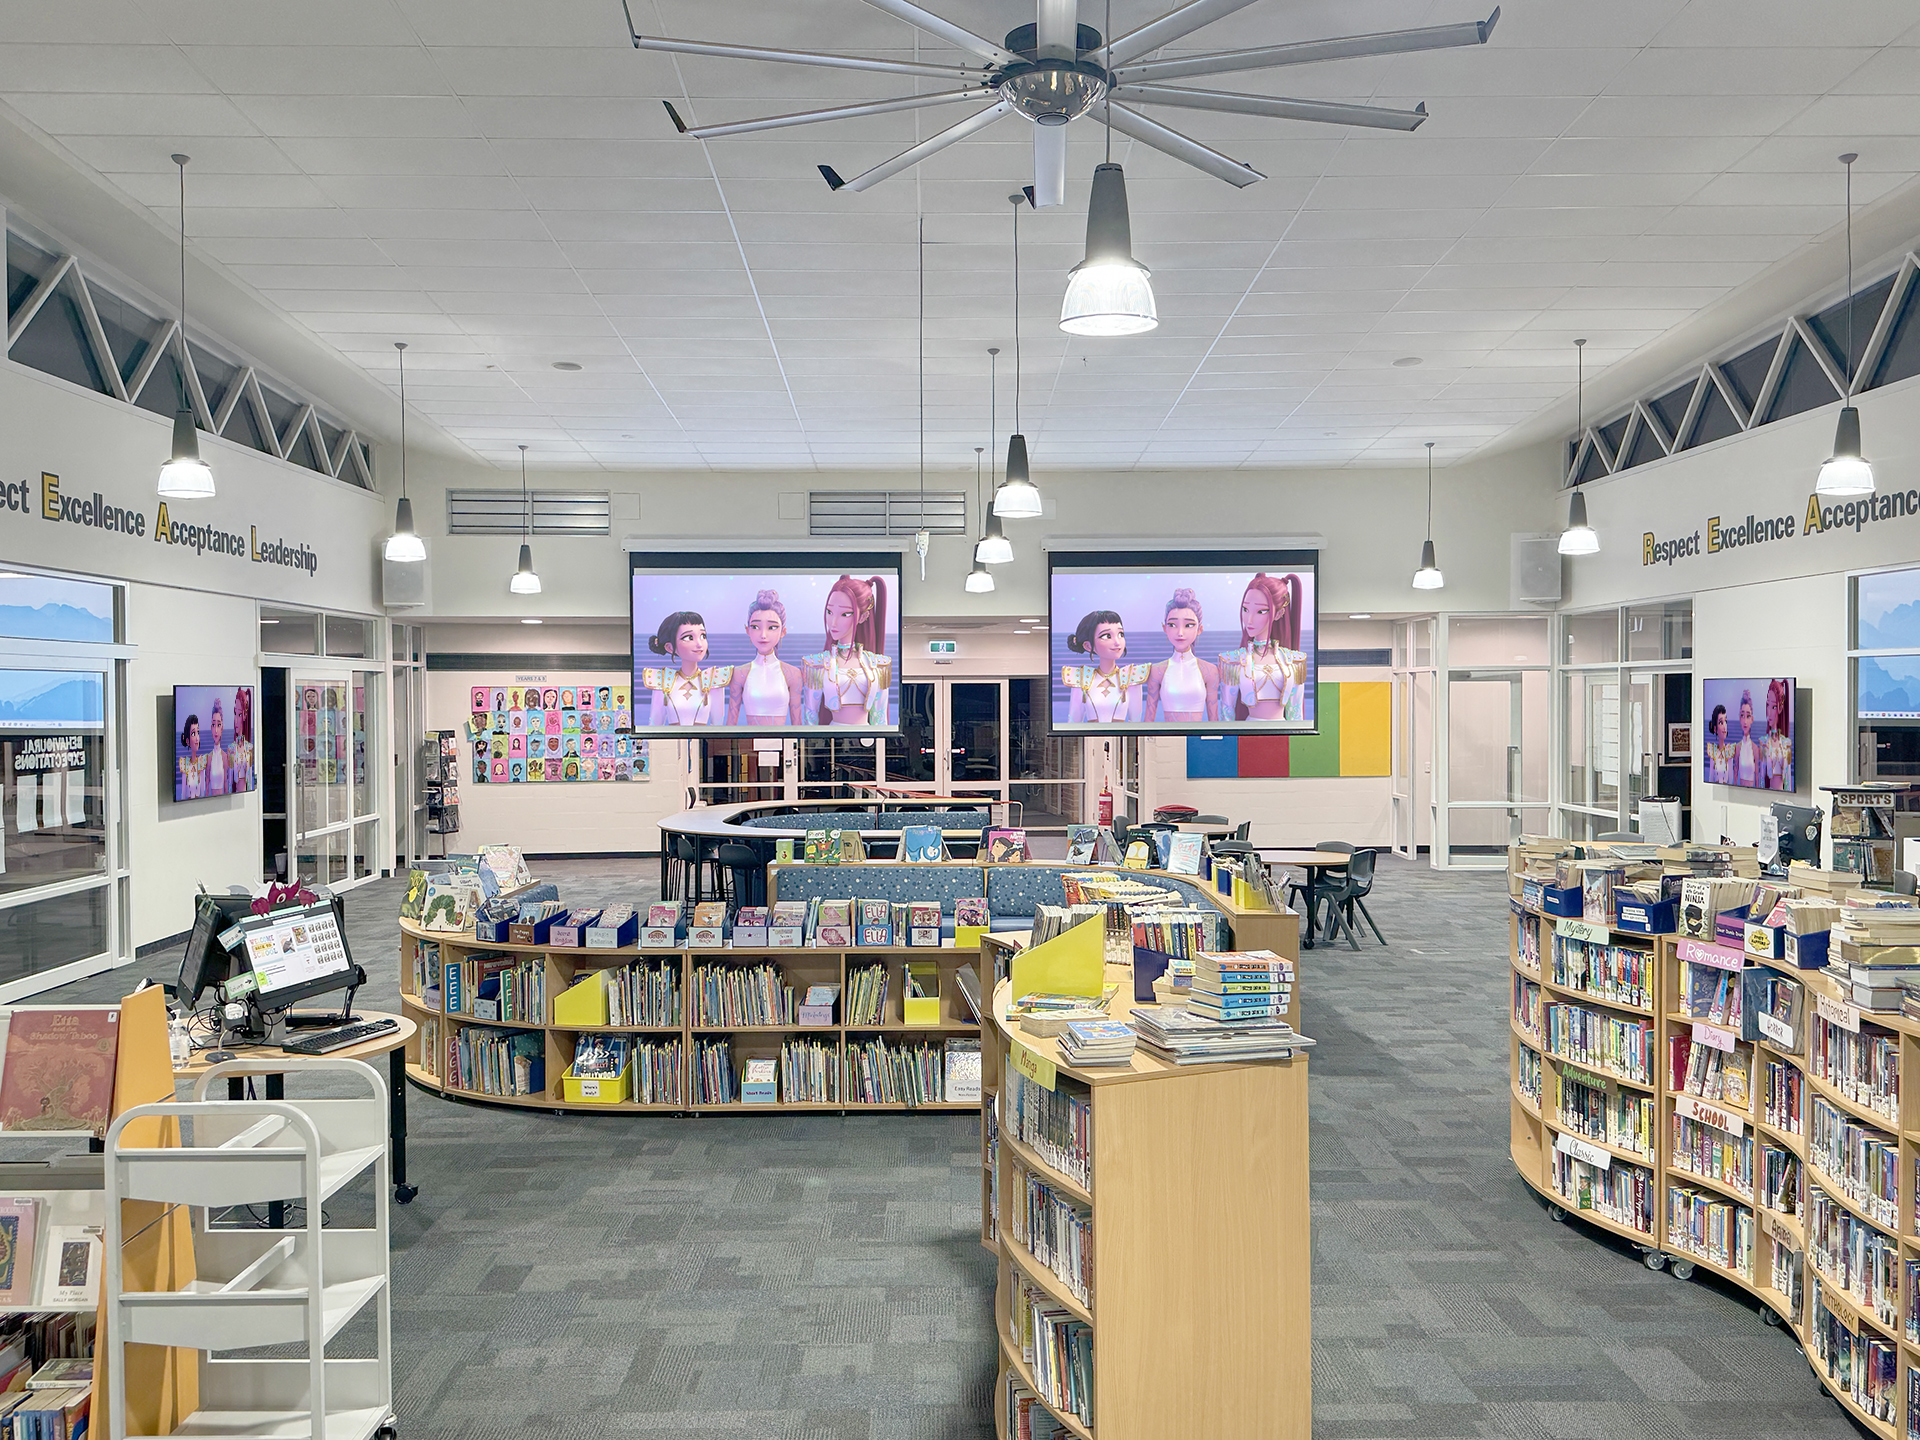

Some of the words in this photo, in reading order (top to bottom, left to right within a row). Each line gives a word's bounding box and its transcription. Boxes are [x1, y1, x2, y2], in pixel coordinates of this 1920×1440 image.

[41, 470, 146, 538] Excellence
[154, 501, 246, 557] Acceptance
[250, 524, 318, 577] Leadership
[1642, 531, 1700, 566] Respect
[1707, 515, 1795, 554] Excellence
[1803, 489, 1920, 537] Acceptanc
[1840, 794, 1892, 805] SPORTS
[1685, 894, 1705, 904] NINJA
[865, 903, 887, 919] ELLA
[864, 928, 888, 943] ELLA
[1564, 921, 1593, 940] Mystery
[51, 1014, 79, 1026] Etta
[30, 1031, 68, 1040] Shadow
[69, 1031, 98, 1040] Taboo
[1704, 1026, 1725, 1047] Diary
[1021, 1050, 1037, 1079] Manga
[1562, 1063, 1607, 1090] Adventure
[1692, 1102, 1729, 1131] SCHOOL
[1569, 1138, 1595, 1163] Classic
